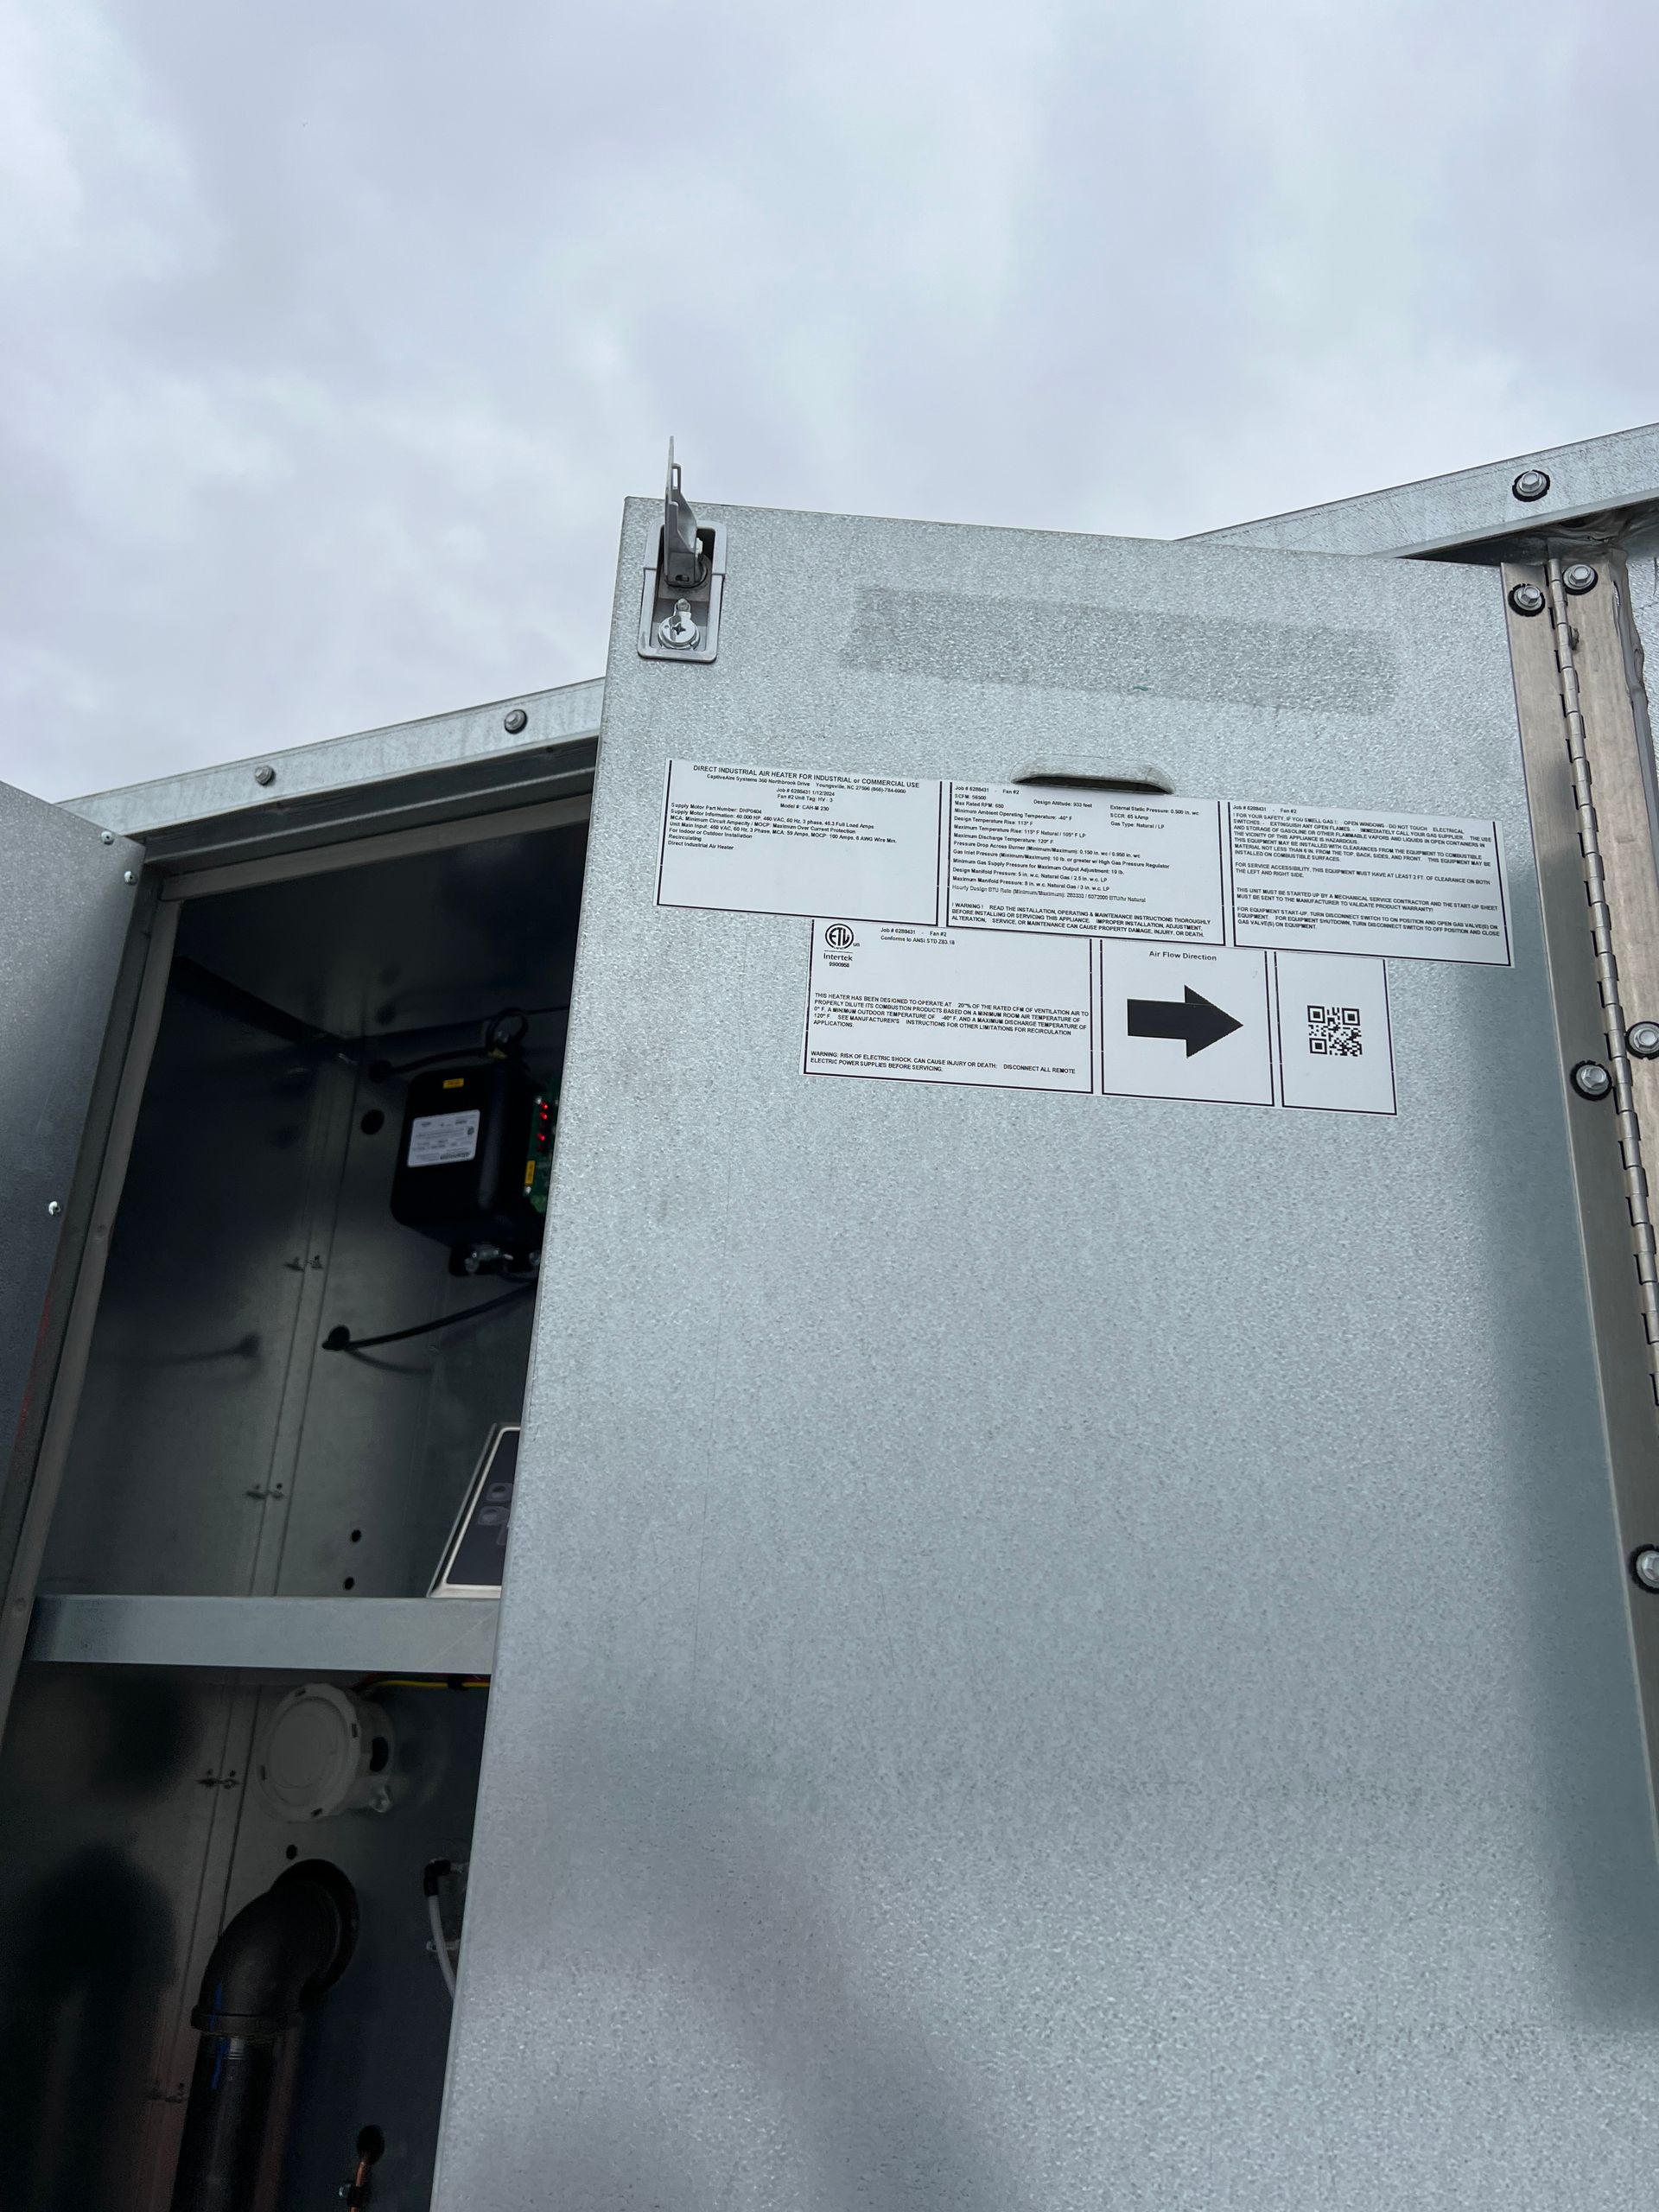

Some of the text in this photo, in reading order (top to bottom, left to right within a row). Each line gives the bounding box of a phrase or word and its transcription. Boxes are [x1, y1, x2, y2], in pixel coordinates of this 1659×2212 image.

[718, 766, 758, 775] INDUSTRIAL
[813, 774, 852, 783] INDUSTRIAL
[861, 778, 906, 787] COMMERCIAL
[829, 926, 850, 946] ETL
[823, 952, 853, 961] Intertek
